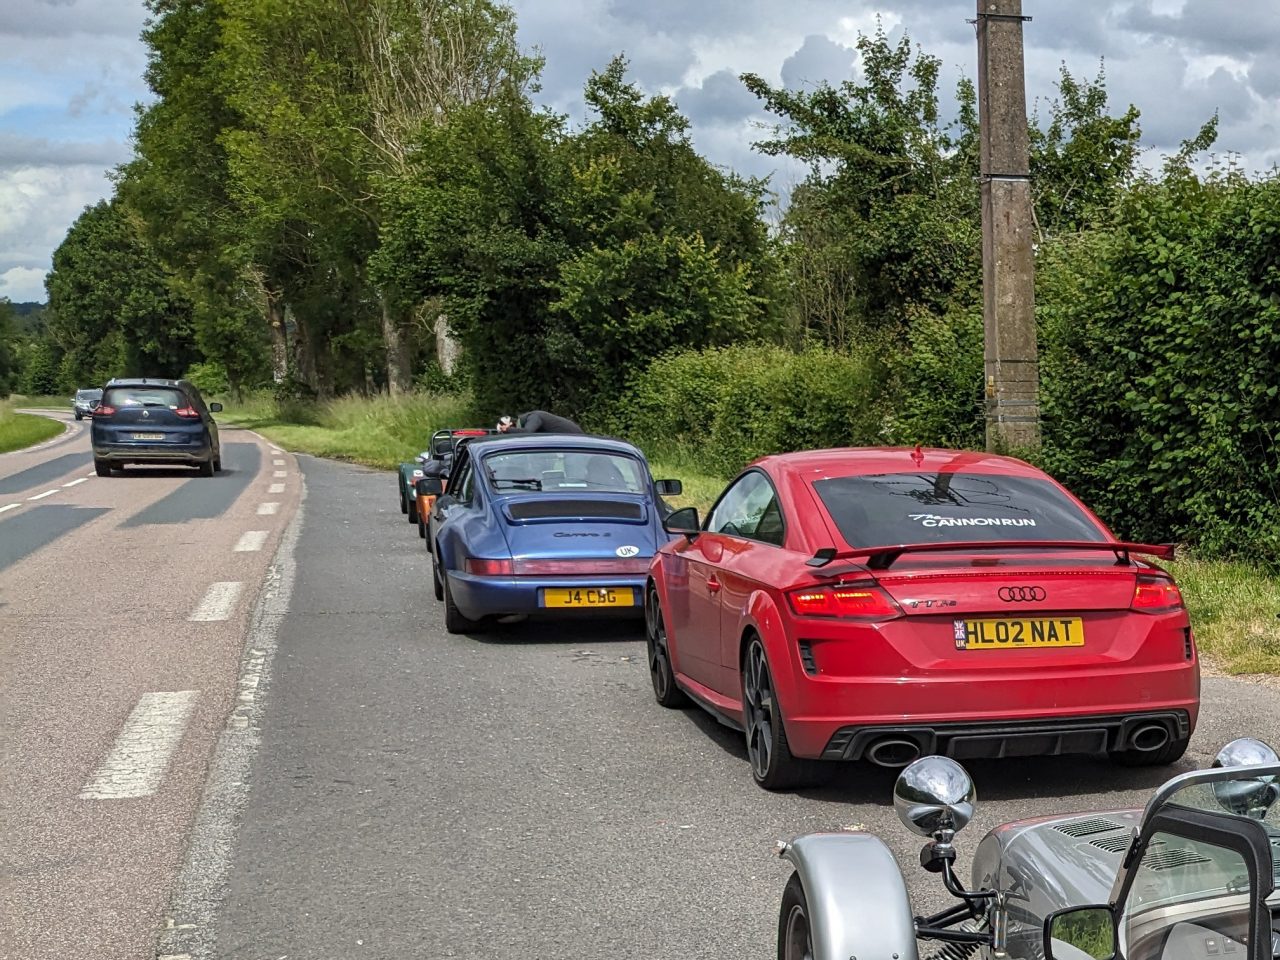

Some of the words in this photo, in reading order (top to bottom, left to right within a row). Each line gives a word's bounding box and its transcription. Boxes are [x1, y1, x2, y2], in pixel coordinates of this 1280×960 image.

[620, 547, 635, 556] UK
[564, 591, 582, 604] J4
[586, 590, 616, 604] CBG
[966, 621, 1025, 644] HL02
[1031, 620, 1073, 643] NAT
[956, 640, 966, 648] UK
